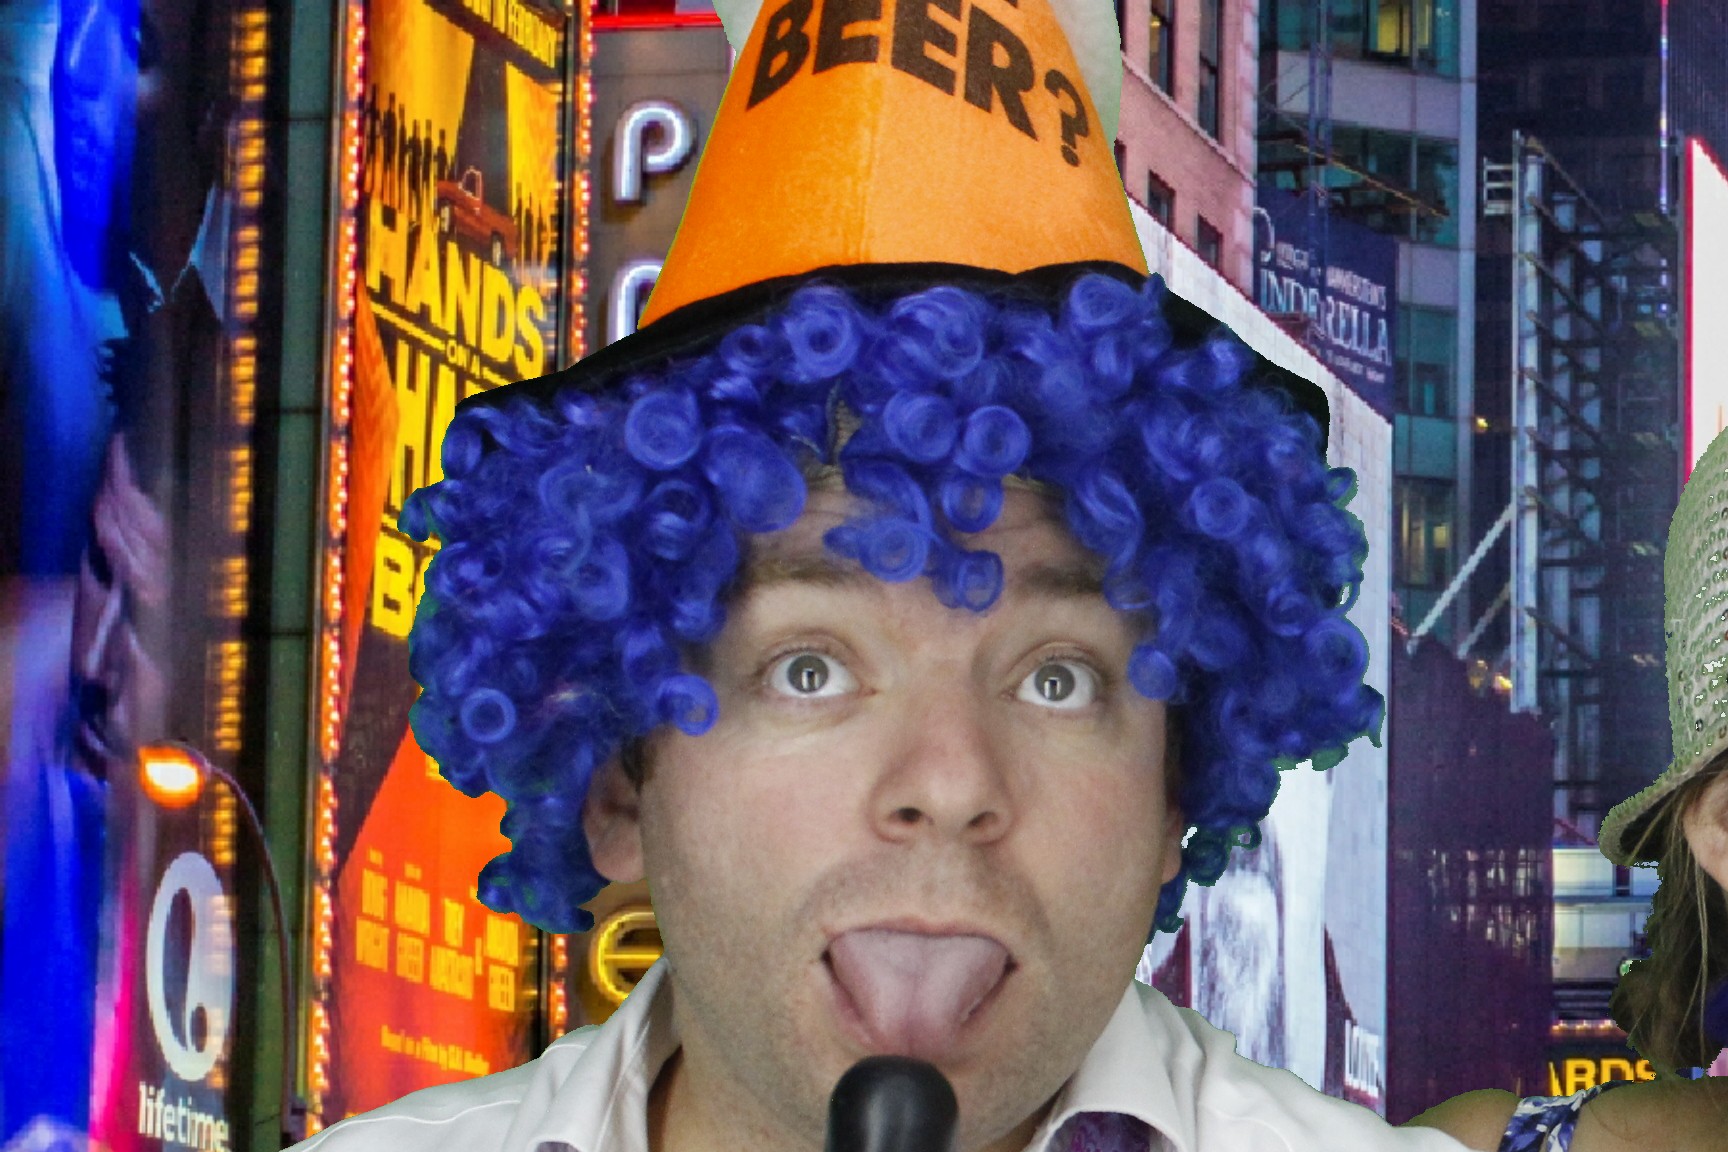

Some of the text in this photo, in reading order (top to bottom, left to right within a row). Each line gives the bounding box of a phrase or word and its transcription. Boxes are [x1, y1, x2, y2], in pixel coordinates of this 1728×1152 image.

[745, 0, 1090, 168] BEER?
[366, 198, 545, 382] HANDS
[446, 338, 468, 372] ON
